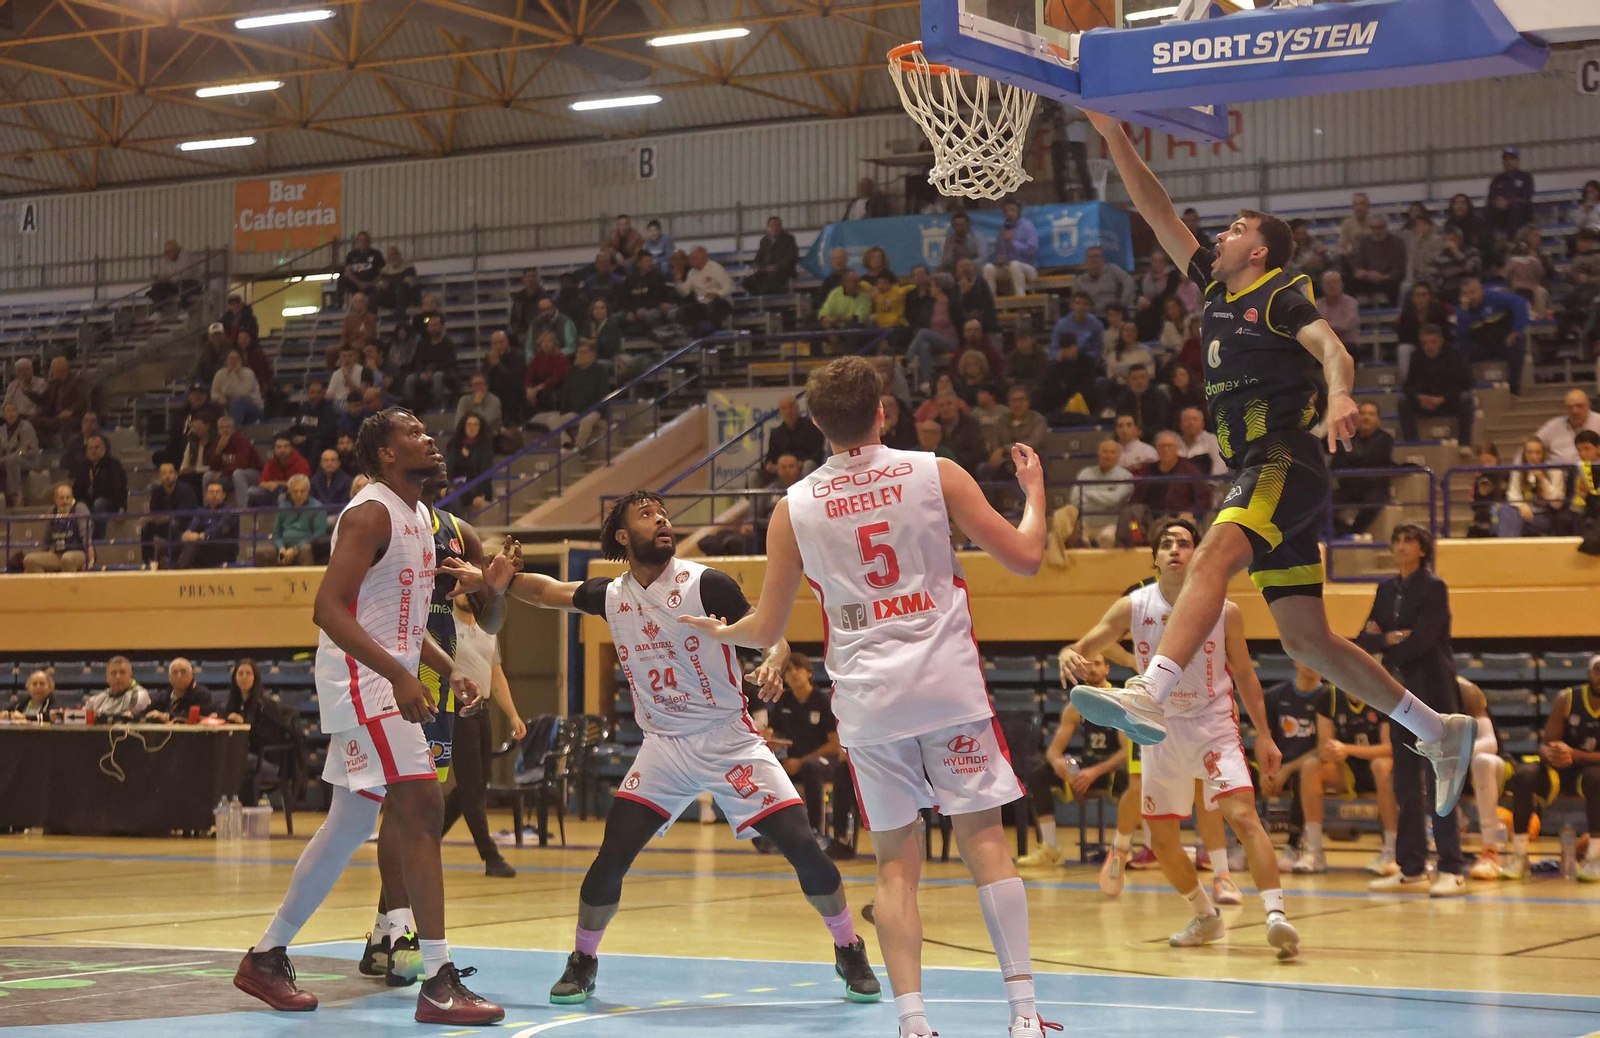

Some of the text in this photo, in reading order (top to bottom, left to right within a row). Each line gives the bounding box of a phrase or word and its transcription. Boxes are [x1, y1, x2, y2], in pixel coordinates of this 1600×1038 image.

[1152, 34, 1251, 65] SPORT
[1582, 61, 1600, 93] C
[640, 147, 654, 178] B
[269, 180, 307, 203] Bar
[22, 204, 35, 231] A
[240, 201, 337, 232] Cafetería
[1207, 339, 1222, 369] 0
[825, 484, 904, 519] GREELEY
[855, 520, 900, 590] 5
[179, 583, 235, 597] PRENSA
[872, 590, 937, 620] IXMA
[647, 667, 678, 692] 24
[1090, 732, 1108, 749] 22
[942, 754, 989, 767] HYUNDA
